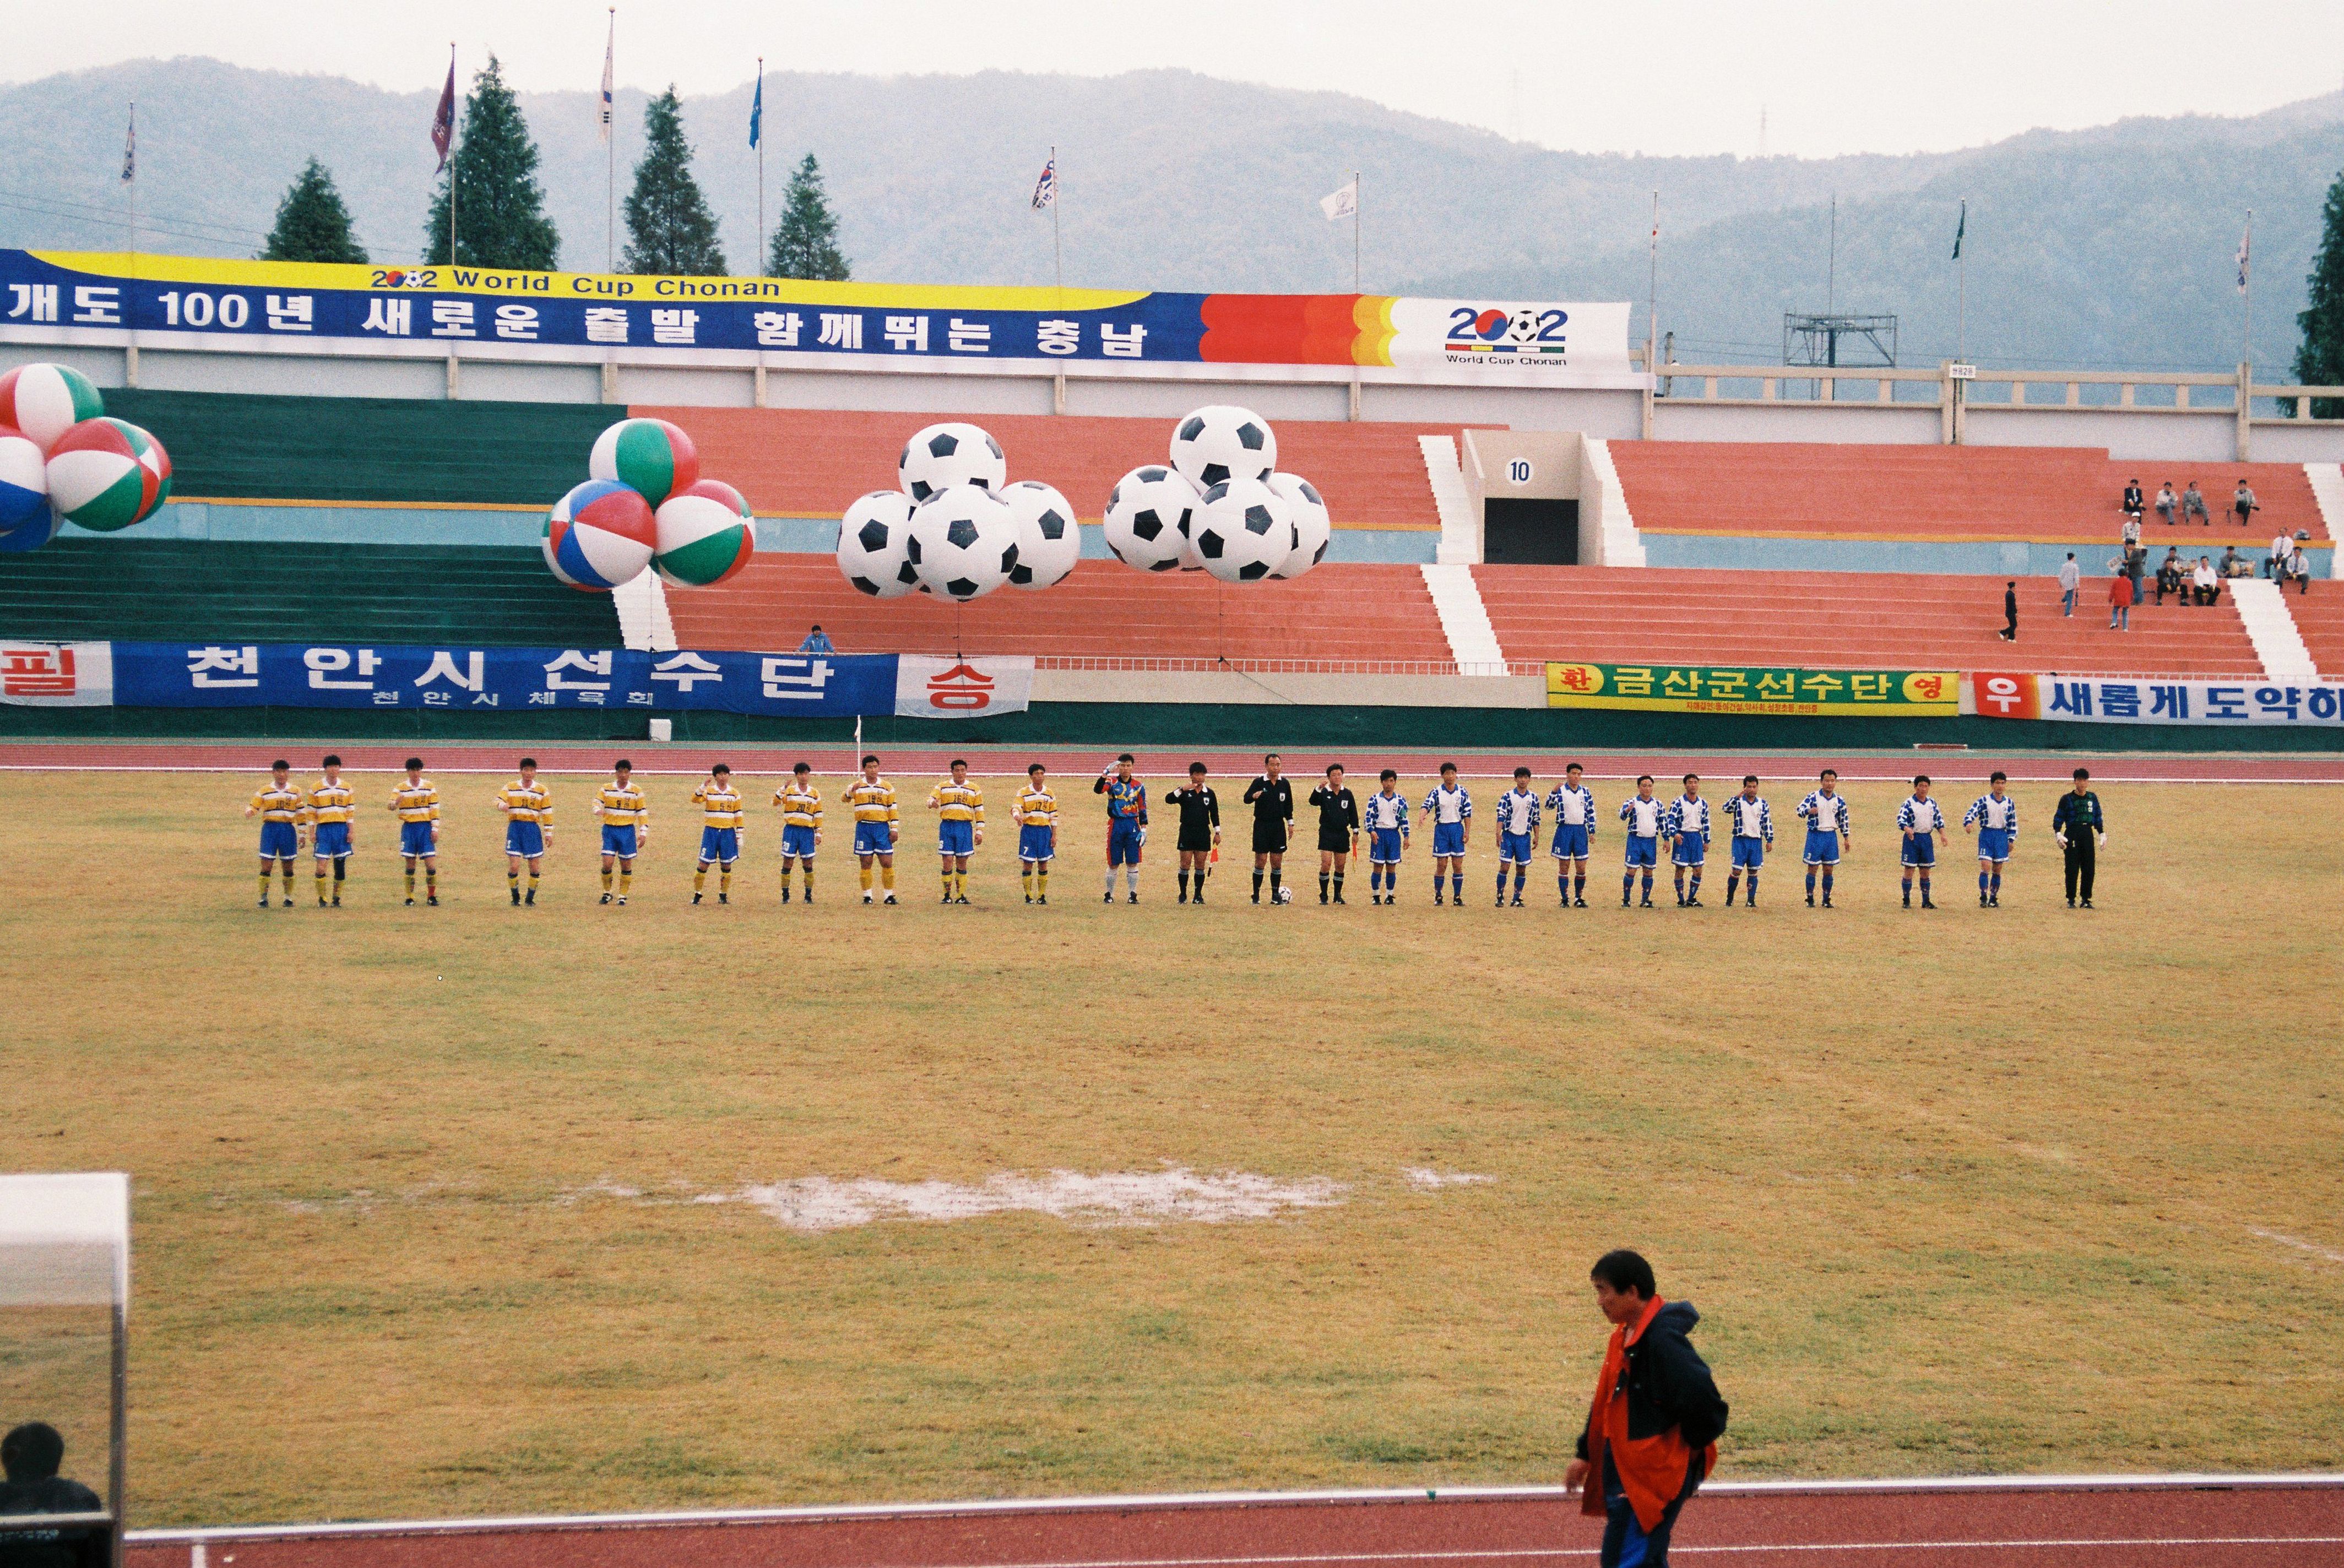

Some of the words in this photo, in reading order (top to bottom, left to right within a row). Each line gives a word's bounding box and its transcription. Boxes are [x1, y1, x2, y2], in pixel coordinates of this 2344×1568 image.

[453, 270, 549, 291] World
[572, 278, 633, 297] Cup
[664, 279, 779, 296] Chonan
[9, 284, 120, 323] 개도
[158, 292, 313, 331] 100년
[361, 298, 539, 339] 새로운
[585, 307, 699, 344] 출발
[1037, 319, 1148, 357] 충남
[1447, 355, 1483, 364] World
[1489, 357, 1514, 366] Cup
[1511, 462, 1529, 481] 10
[1, 649, 75, 696] 필
[927, 665, 995, 709] 승
[1560, 667, 1592, 691] 환
[1913, 676, 1942, 699] 영
[1987, 677, 2021, 713] 우
[2049, 682, 2190, 719] 새롭게
